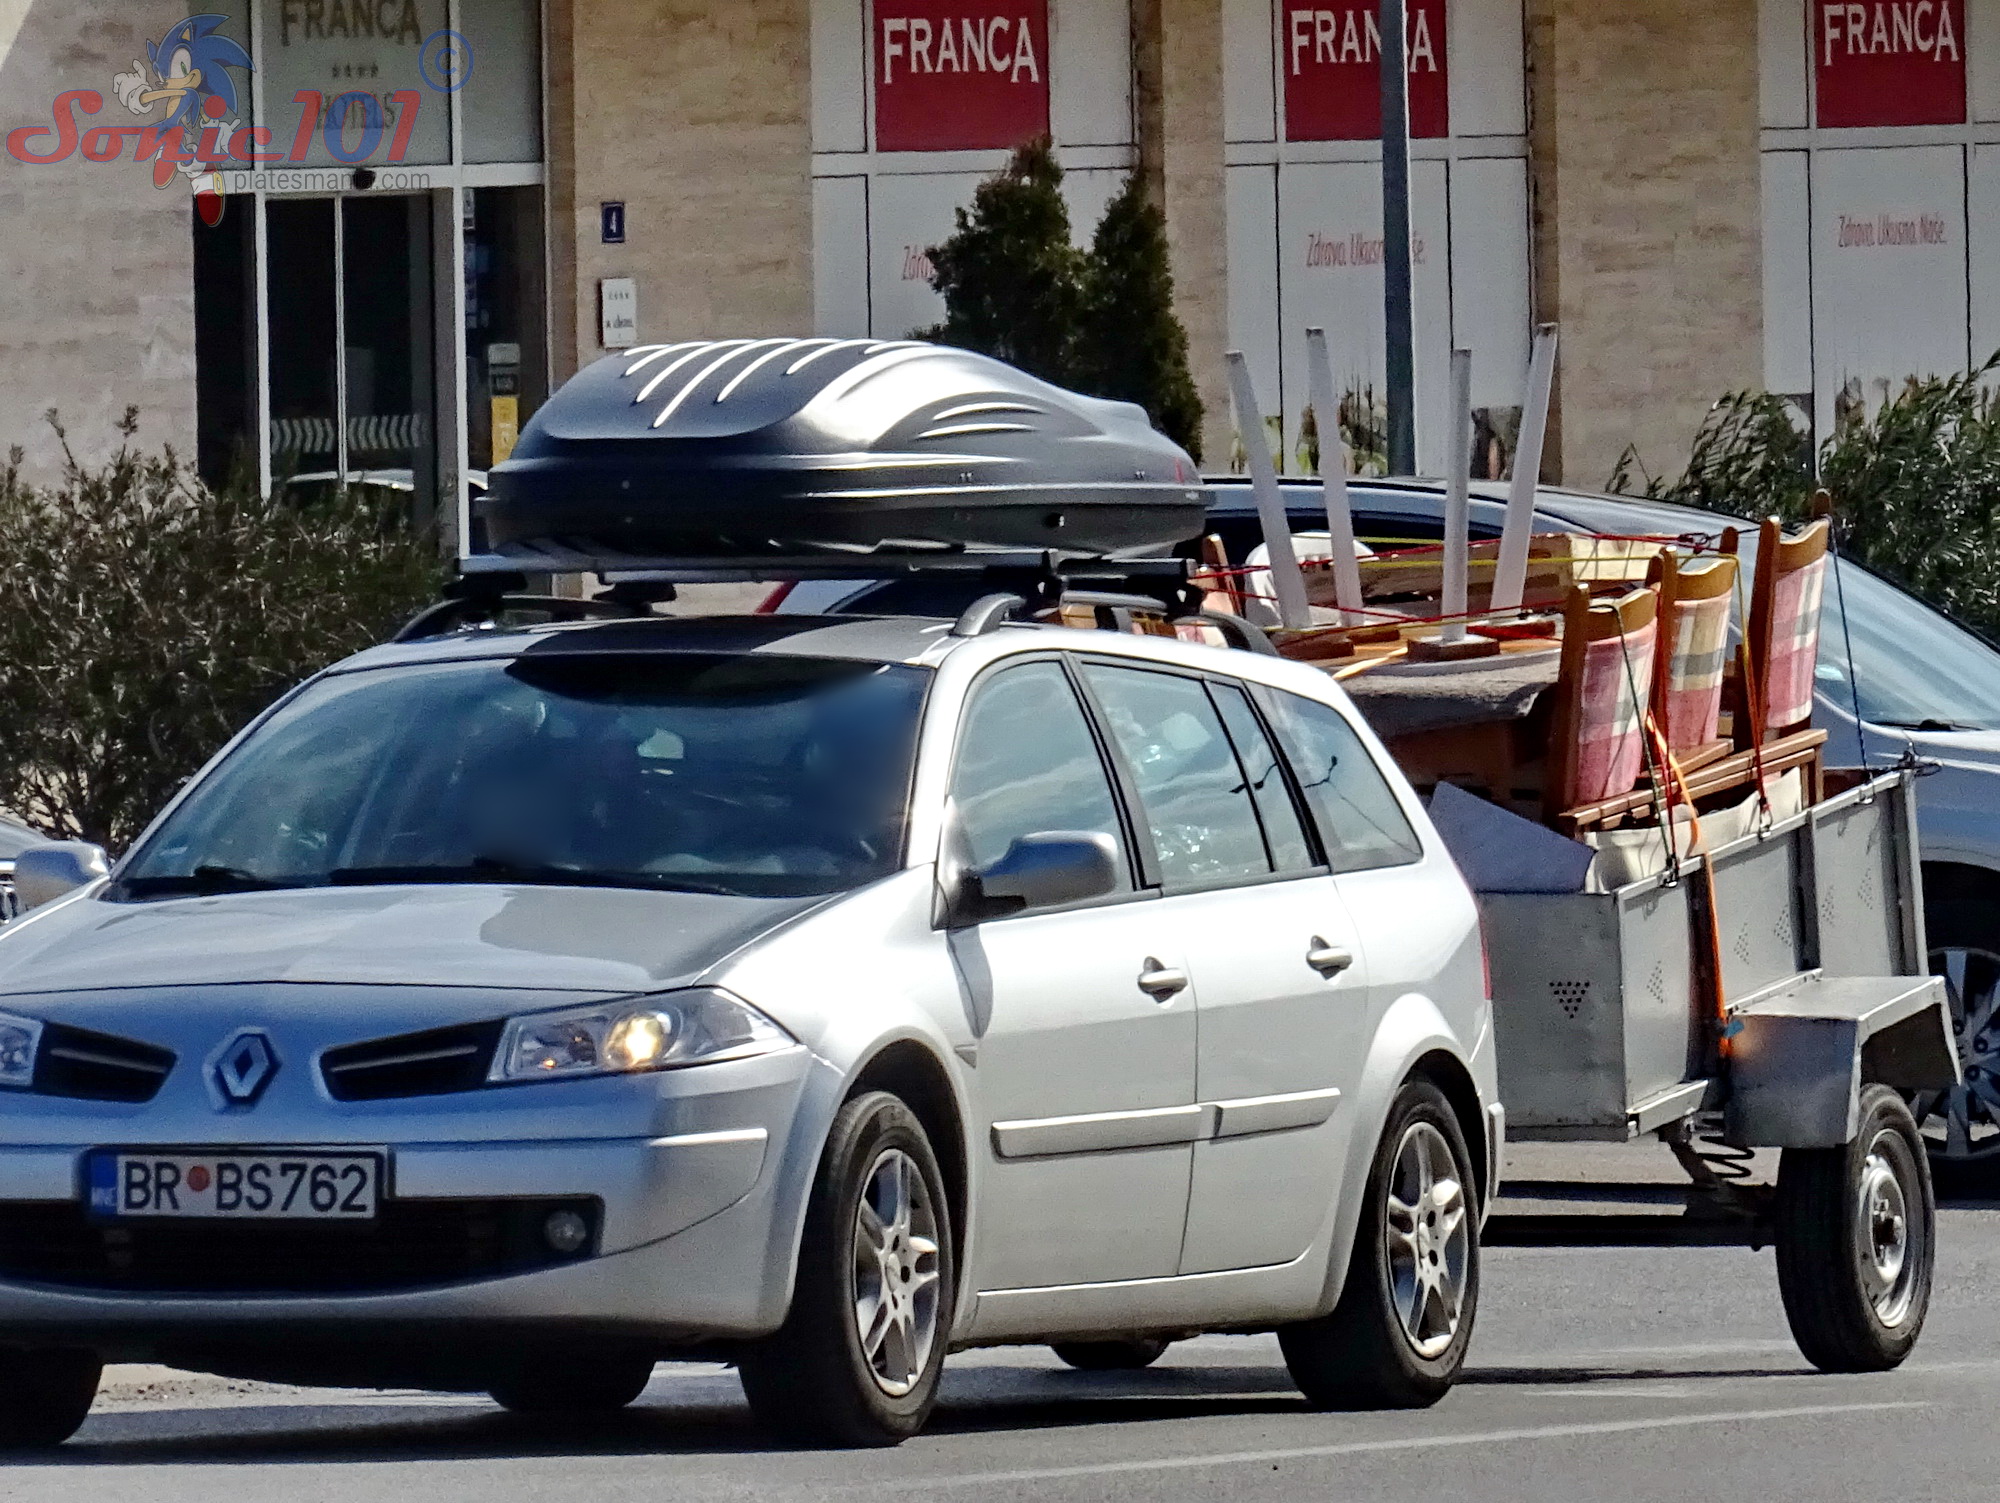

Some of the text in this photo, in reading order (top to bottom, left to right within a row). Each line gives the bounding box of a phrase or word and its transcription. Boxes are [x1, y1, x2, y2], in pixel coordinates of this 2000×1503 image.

[281, 0, 422, 46] FRANCA
[882, 16, 1040, 84] FRANCA
[1290, 9, 1438, 75] FRANA
[1823, 0, 1959, 66] FRANCA
[123, 1160, 368, 1212] BR BS762
